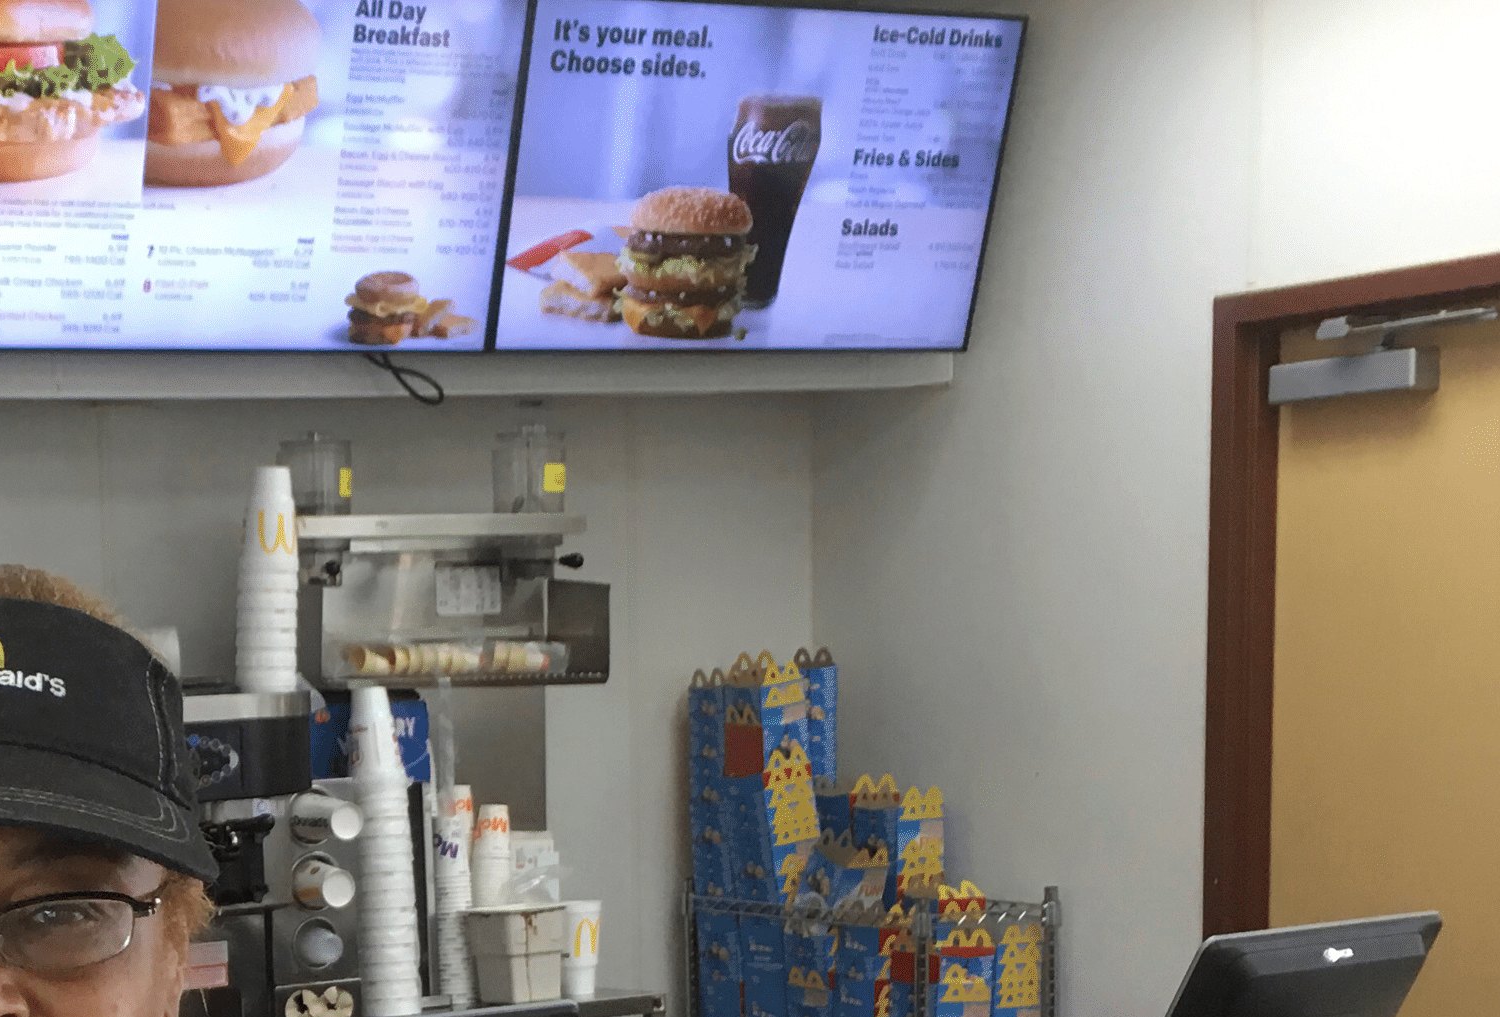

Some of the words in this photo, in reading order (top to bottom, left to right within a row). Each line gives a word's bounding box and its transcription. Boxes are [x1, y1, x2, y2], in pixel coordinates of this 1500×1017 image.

[355, 0, 383, 18] All
[388, 0, 427, 24] Day
[353, 24, 450, 48] Breakfast
[554, 19, 590, 43] It's
[597, 24, 647, 47] your
[652, 25, 713, 48] meal.
[873, 24, 946, 45] Ice-Cold
[949, 28, 1003, 48] Drinks
[550, 49, 635, 75] Choose
[641, 53, 706, 79] sides.
[853, 148, 894, 166] Fries
[898, 149, 910, 167] &
[915, 149, 960, 168] Sides
[841, 218, 898, 237] Salads
